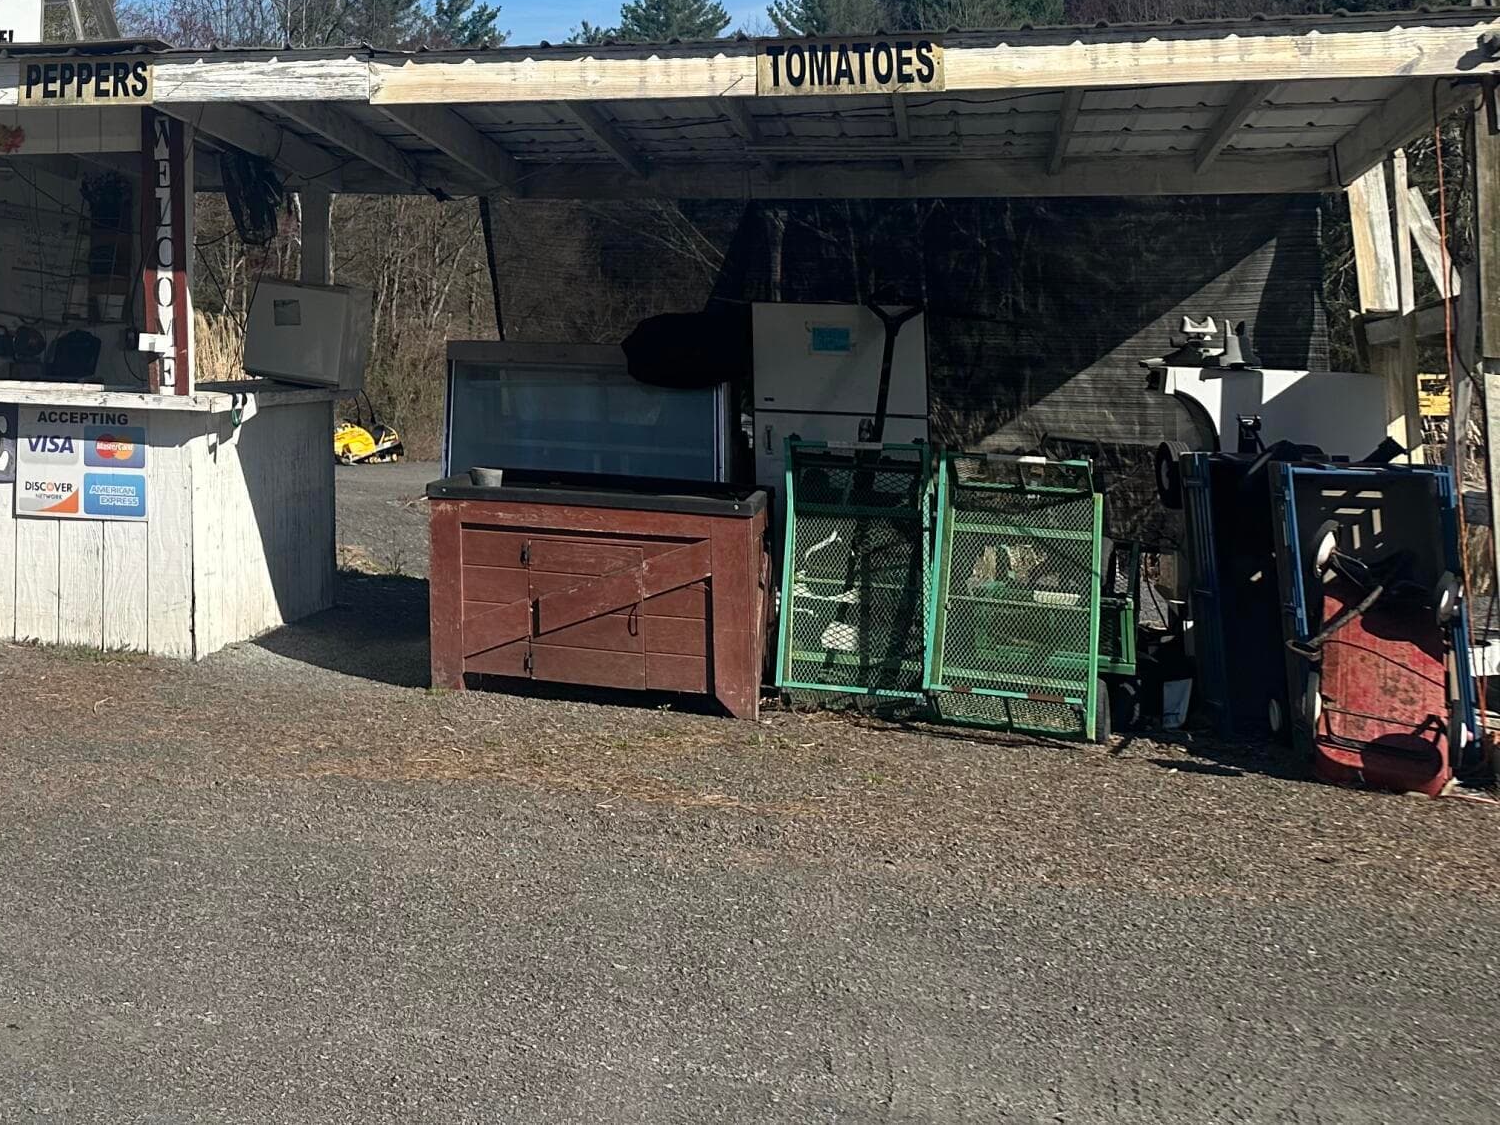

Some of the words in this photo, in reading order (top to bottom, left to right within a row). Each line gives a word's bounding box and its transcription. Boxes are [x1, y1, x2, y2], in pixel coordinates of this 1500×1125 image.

[766, 40, 935, 87] TOMATOES
[26, 61, 147, 98] PEPPERS
[37, 410, 129, 425] ACCEPTING
[27, 436, 75, 453] VISA
[96, 441, 134, 451] MasterCard
[25, 481, 73, 492] DISCOVER
[89, 485, 136, 495] AMERICAN
[99, 496, 140, 506] EXPRESS
